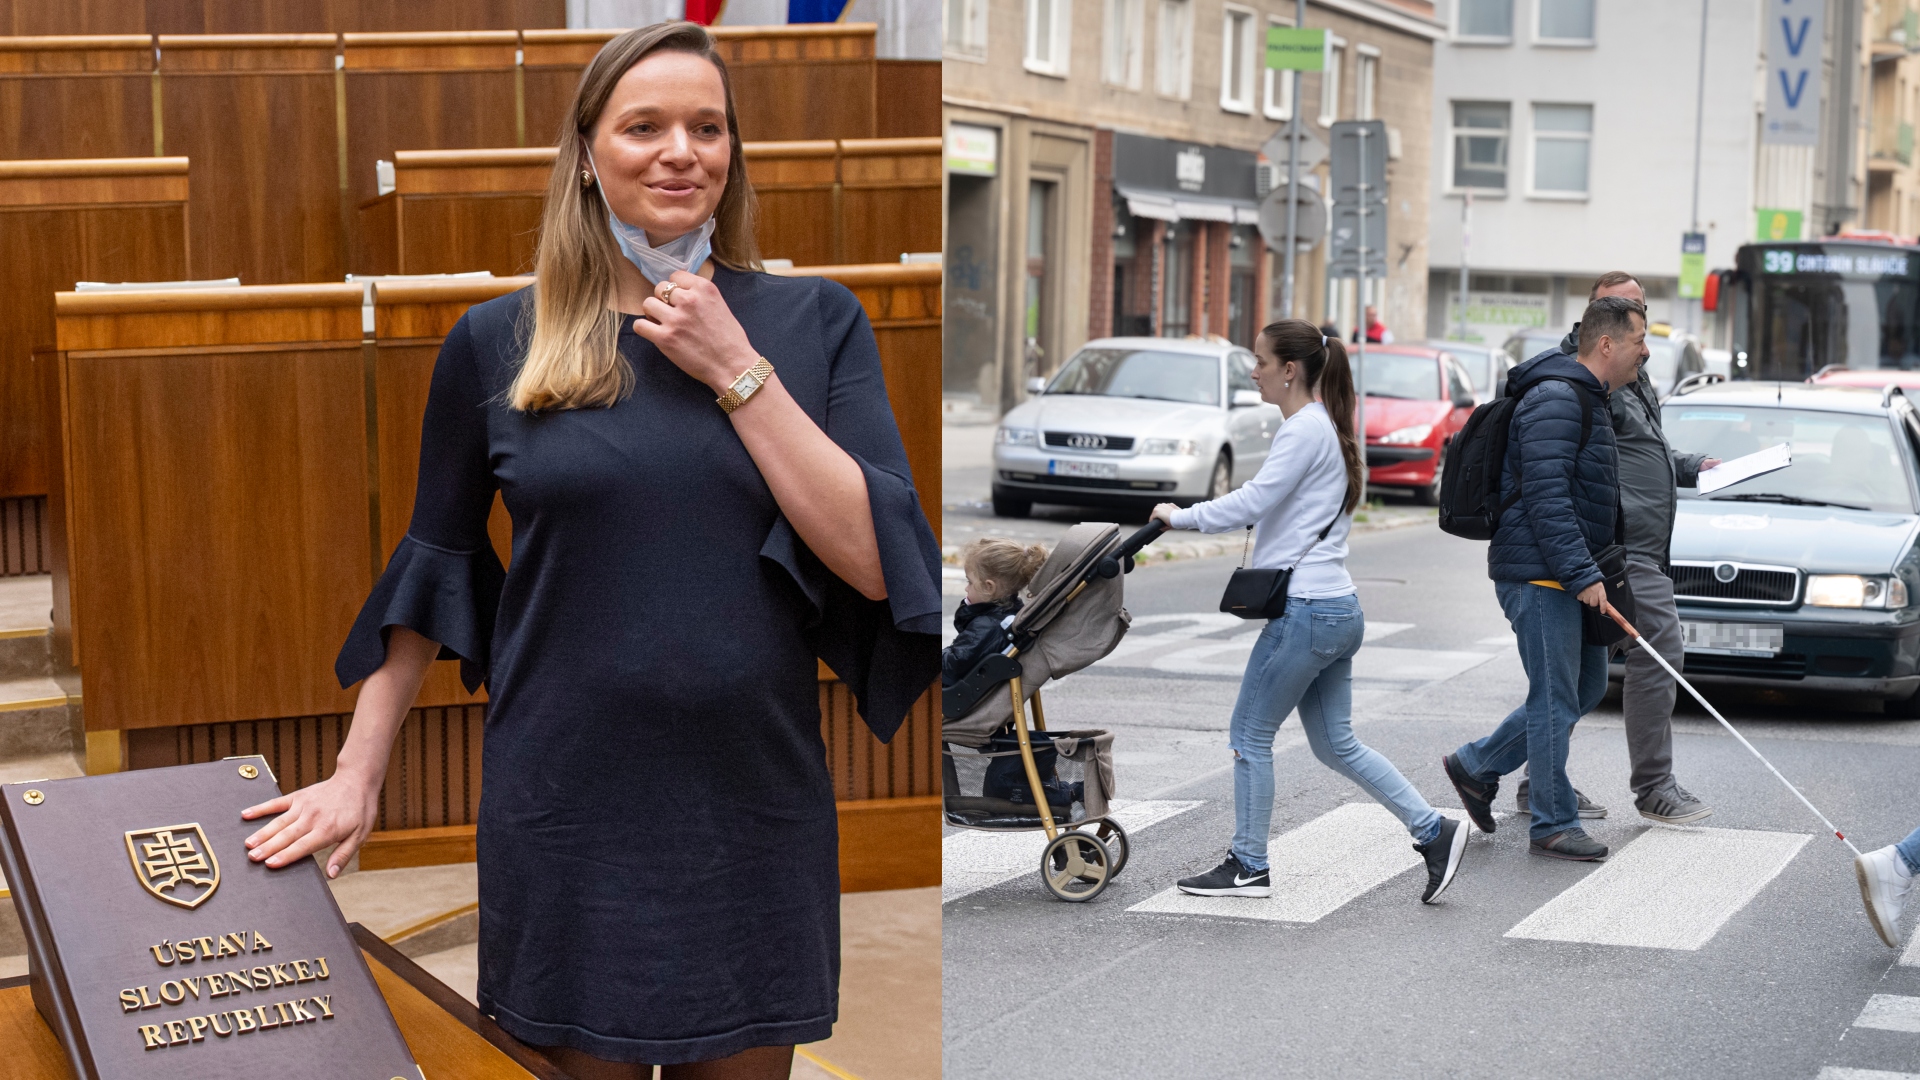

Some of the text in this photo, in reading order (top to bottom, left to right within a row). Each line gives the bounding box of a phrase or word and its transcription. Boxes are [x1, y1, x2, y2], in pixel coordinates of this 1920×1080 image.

[1764, 250, 1794, 273] 39
[149, 930, 273, 967] ÚSTAVA
[119, 957, 331, 1014] SLOVENSKEJ
[138, 994, 335, 1051] REPUBLIKY
